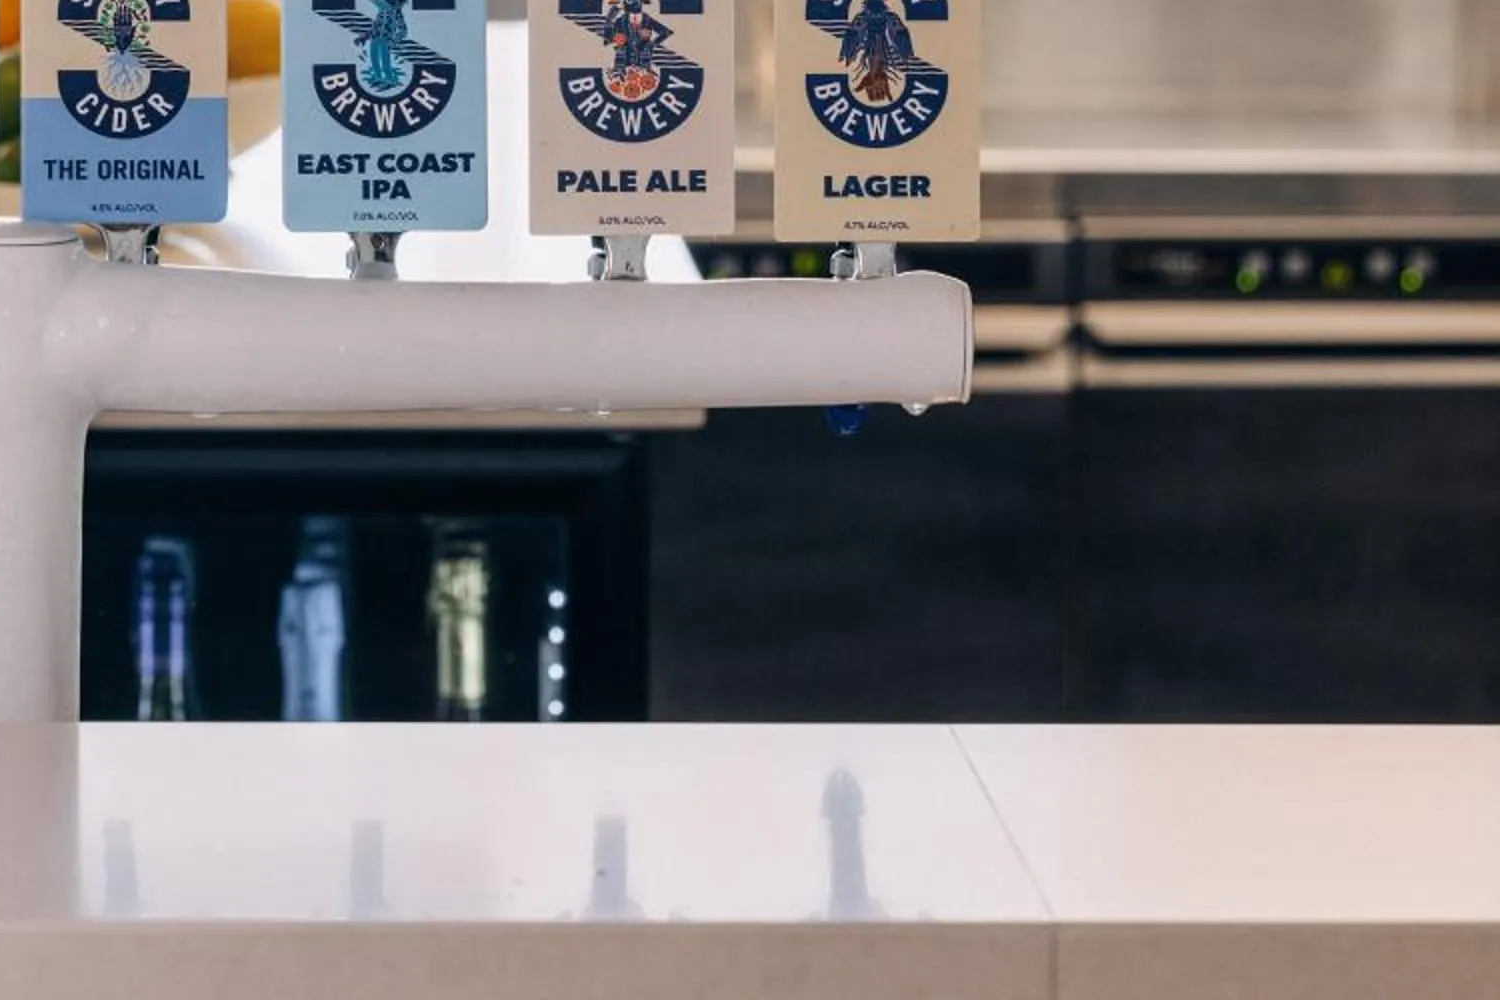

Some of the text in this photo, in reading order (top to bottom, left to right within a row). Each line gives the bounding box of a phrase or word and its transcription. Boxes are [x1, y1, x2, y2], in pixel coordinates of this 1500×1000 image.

[75, 92, 175, 134] CIDER
[321, 70, 448, 133] BREWERY
[567, 74, 695, 137] BREWERY
[813, 80, 940, 142] BREWERY
[43, 158, 205, 181] THE ORIGINAL
[297, 152, 475, 175] EAST COAST
[361, 179, 412, 200] IPA
[557, 169, 707, 193] PALE ALE
[823, 175, 931, 198] LAGER
